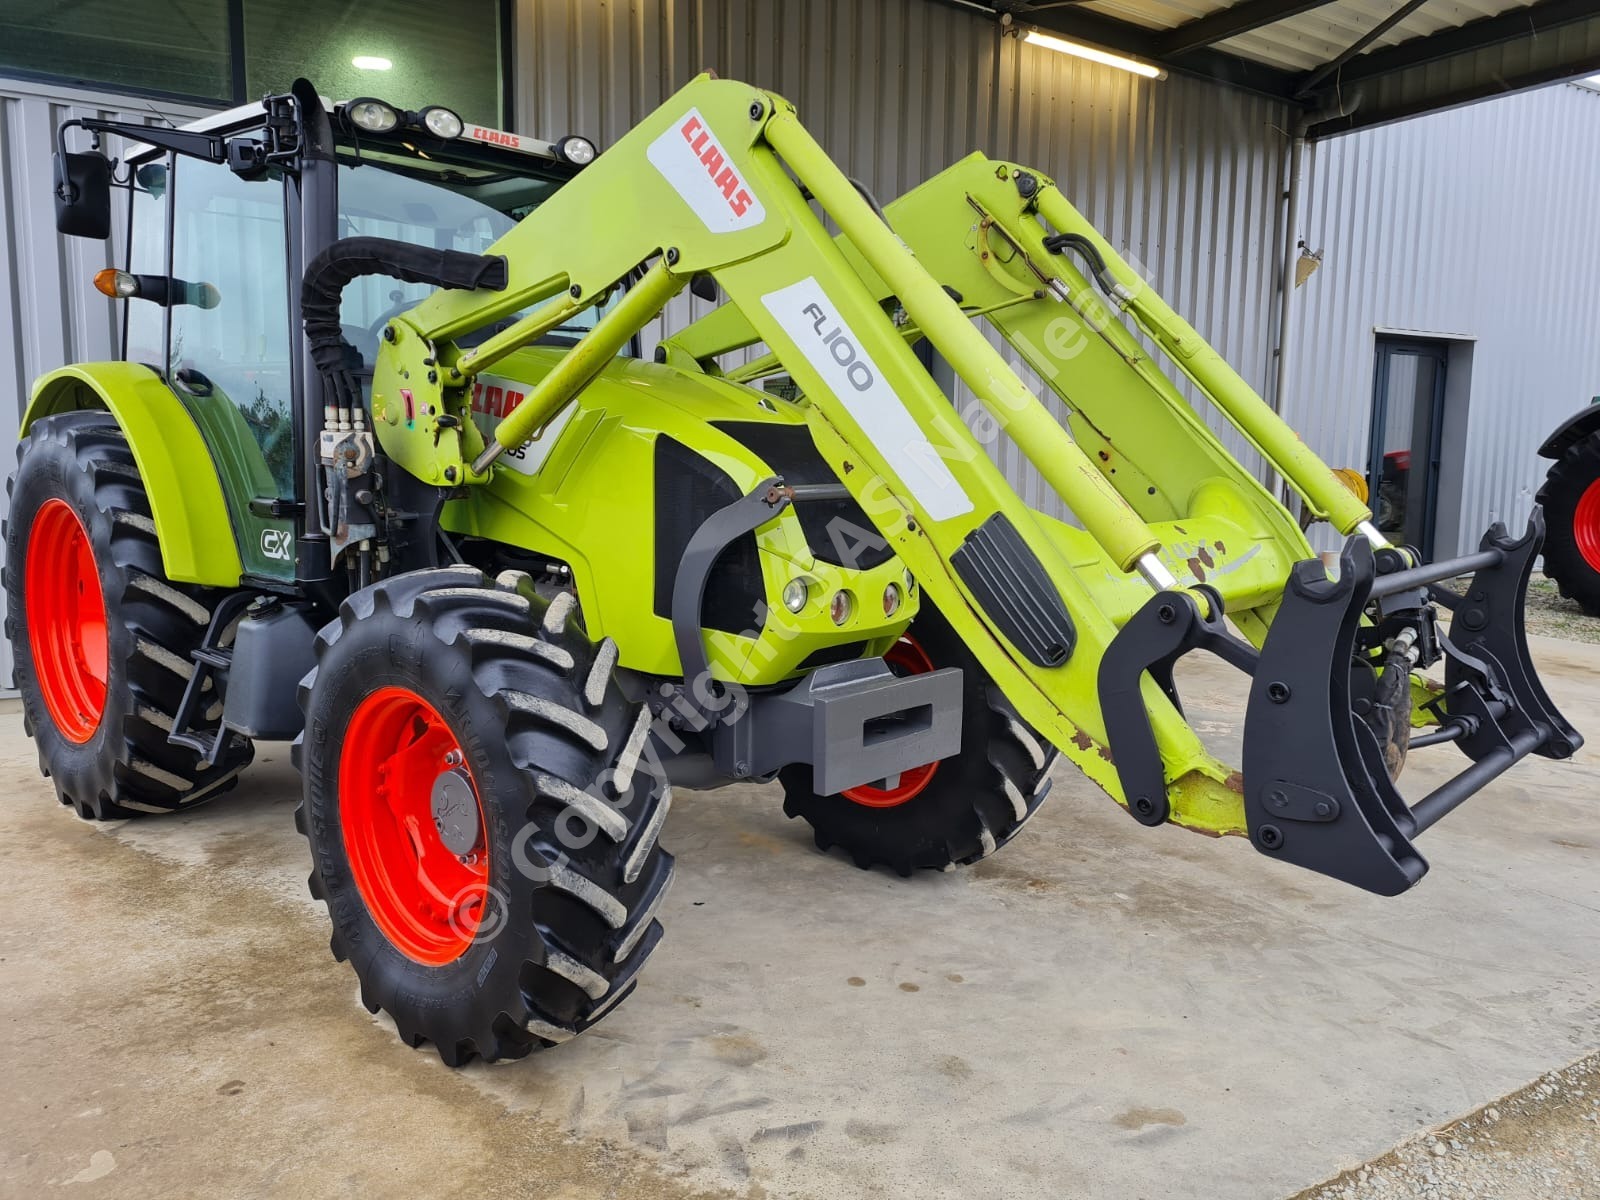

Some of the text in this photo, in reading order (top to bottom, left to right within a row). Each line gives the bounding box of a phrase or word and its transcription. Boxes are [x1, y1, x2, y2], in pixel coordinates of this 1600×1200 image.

[473, 127, 520, 148] CLAAS
[681, 116, 753, 217] CLAAS
[802, 303, 874, 391] FL100
[471, 383, 525, 419] LAA
[261, 529, 291, 560] CX
